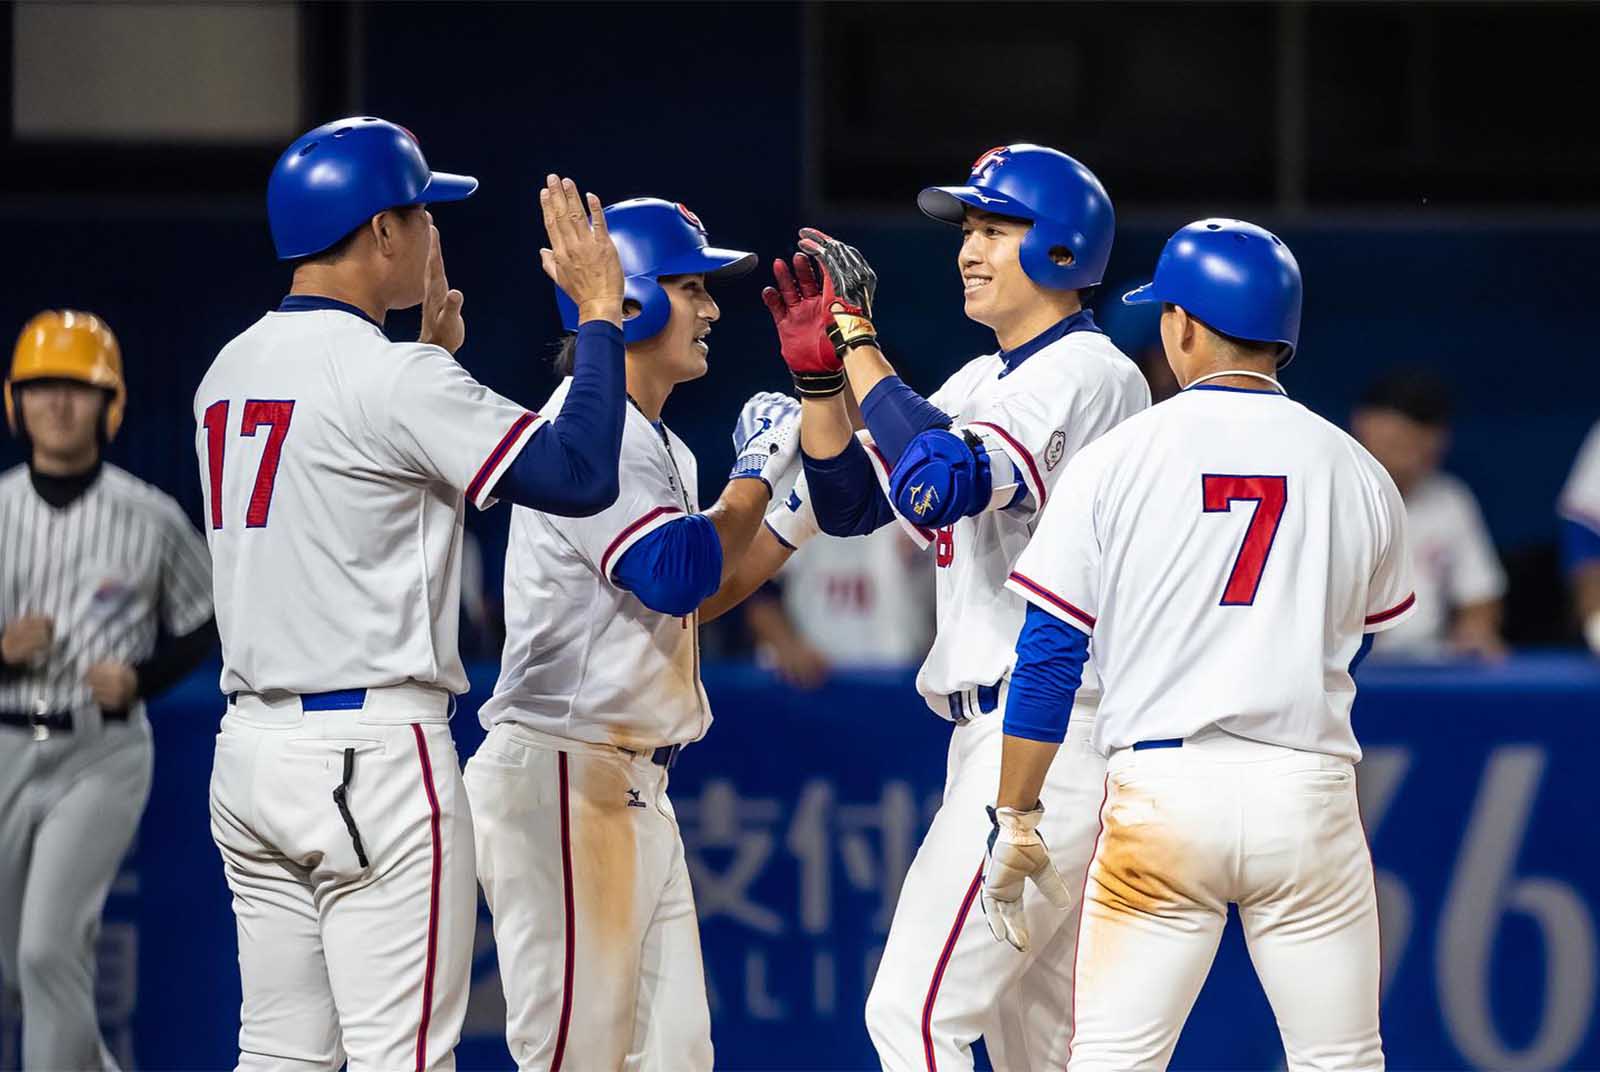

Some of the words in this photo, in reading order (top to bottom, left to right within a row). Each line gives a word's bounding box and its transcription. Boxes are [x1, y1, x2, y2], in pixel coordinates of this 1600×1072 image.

[203, 399, 296, 530] 17
[1201, 474, 1288, 606] 7
[674, 779, 943, 936] 支付
